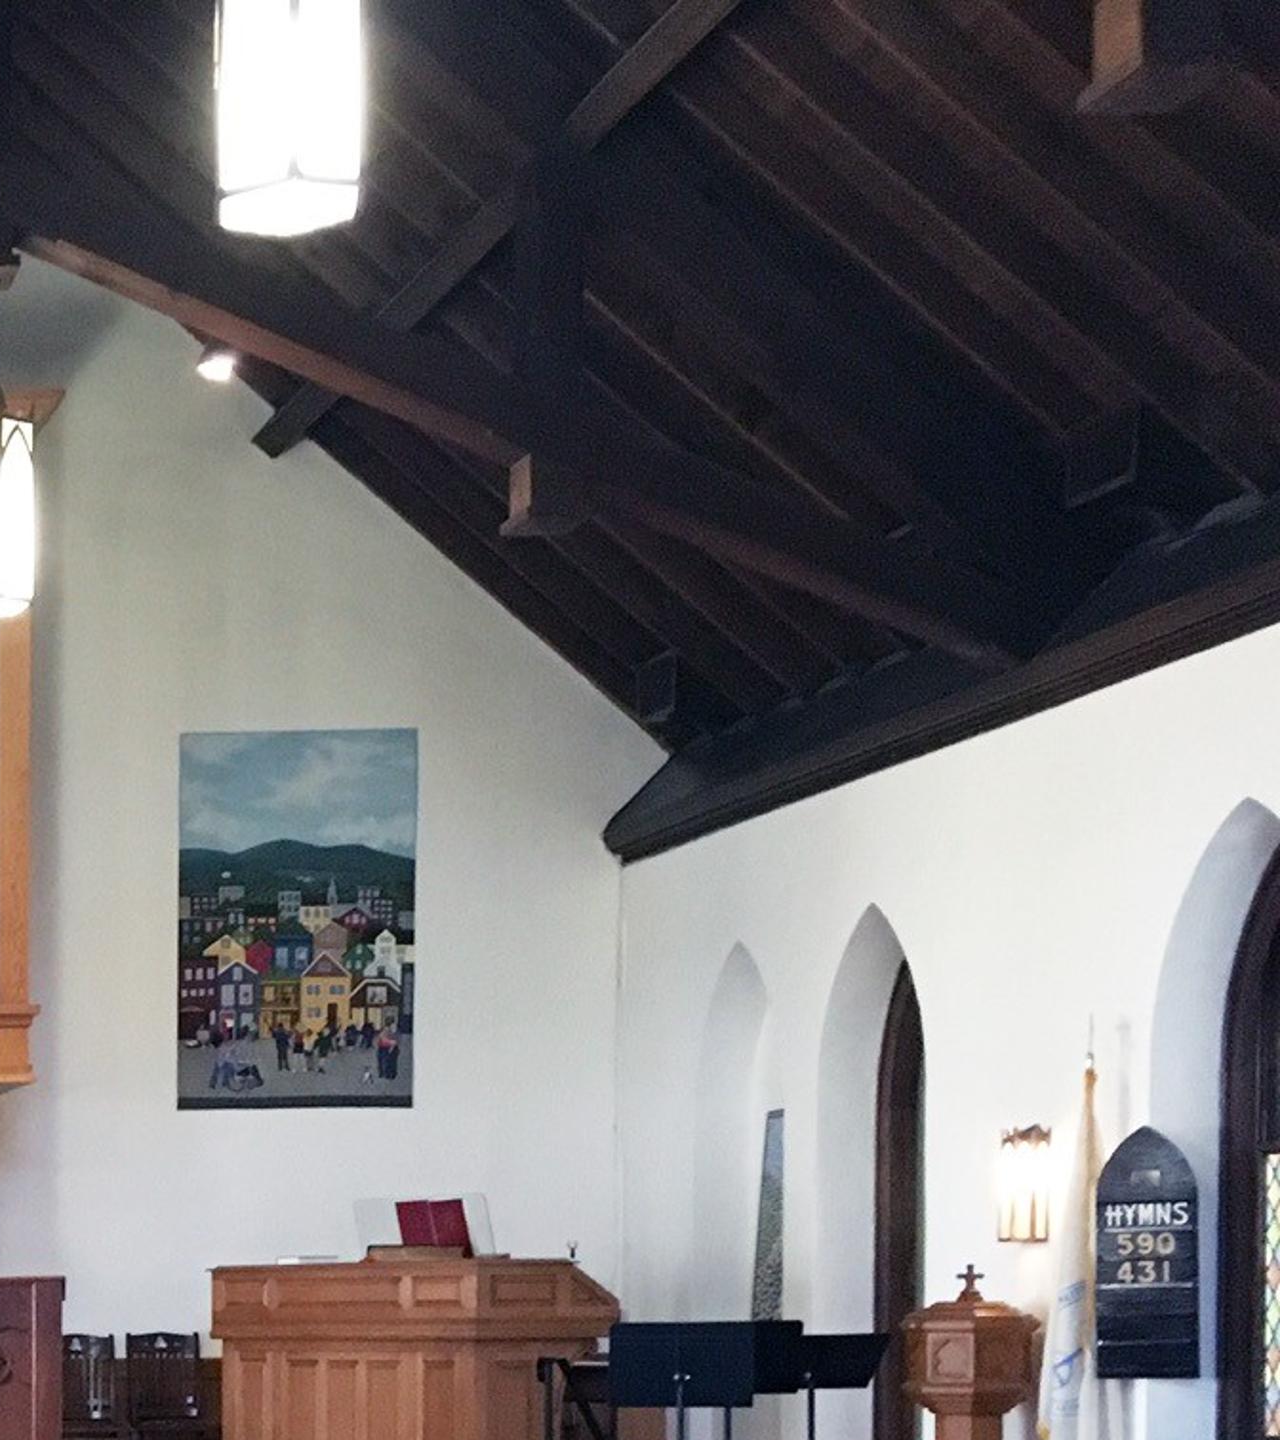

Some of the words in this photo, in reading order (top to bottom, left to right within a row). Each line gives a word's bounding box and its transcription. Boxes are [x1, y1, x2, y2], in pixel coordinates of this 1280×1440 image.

[1105, 1202, 1189, 1226] HYMNS
[1117, 1233, 1176, 1255] 590
[1117, 1261, 1171, 1284] 431
